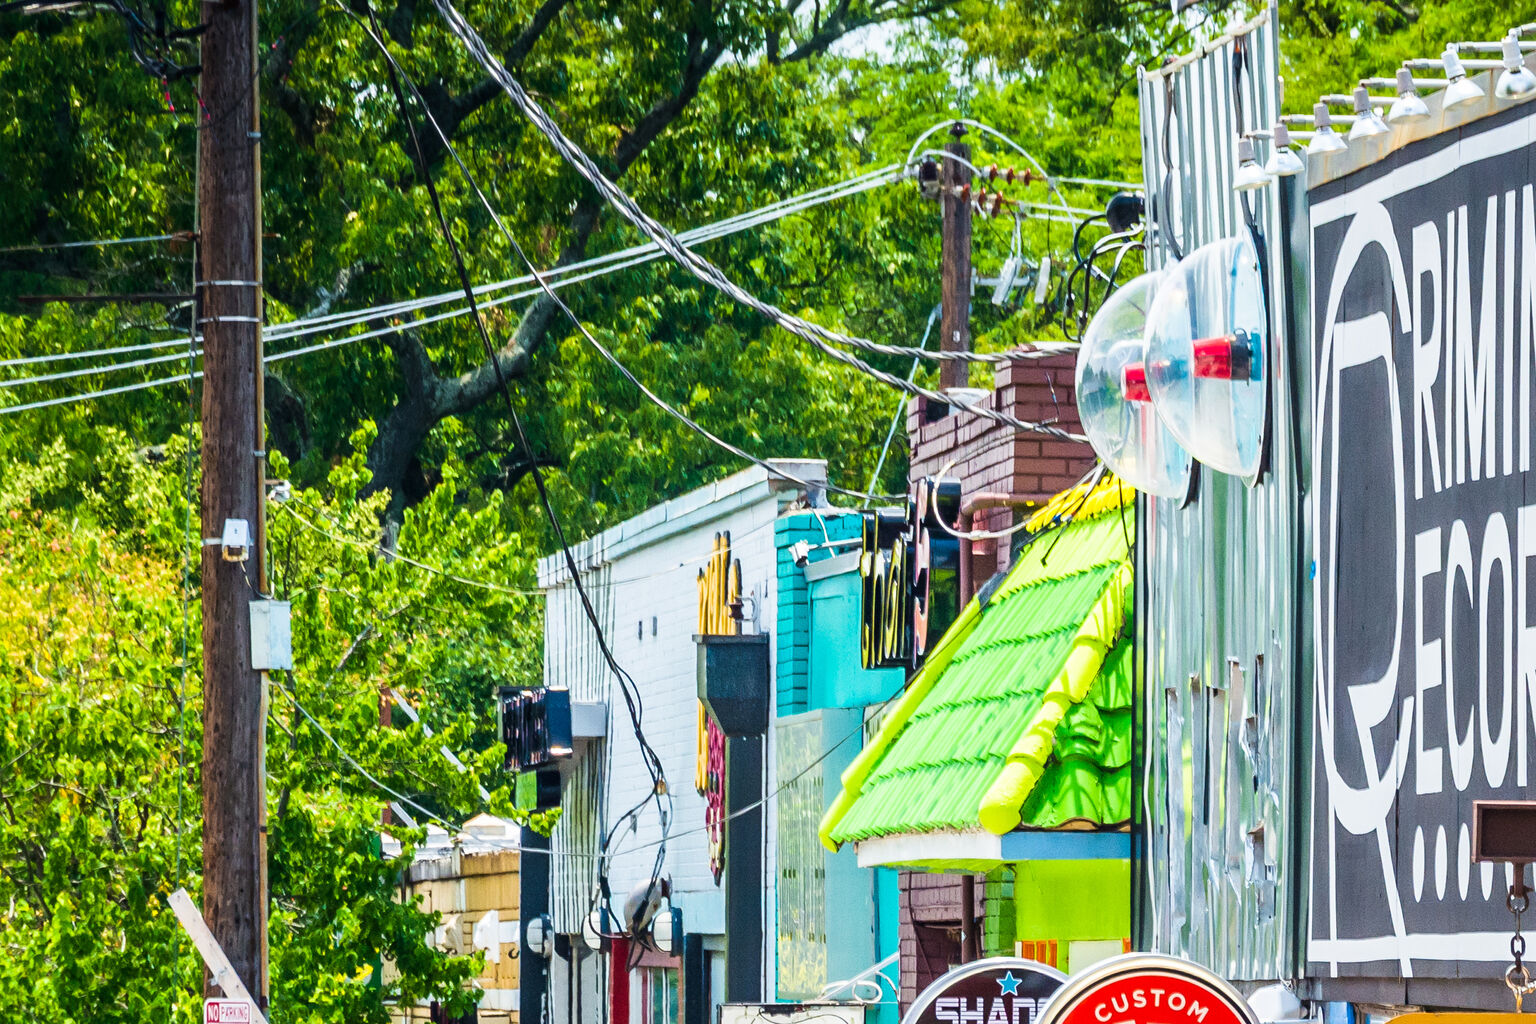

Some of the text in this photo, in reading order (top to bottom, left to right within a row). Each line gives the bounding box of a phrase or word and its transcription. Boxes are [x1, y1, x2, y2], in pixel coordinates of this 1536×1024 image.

[207, 1004, 248, 1022] NO PARKING
[1094, 988, 1210, 1023] CUSTOM
